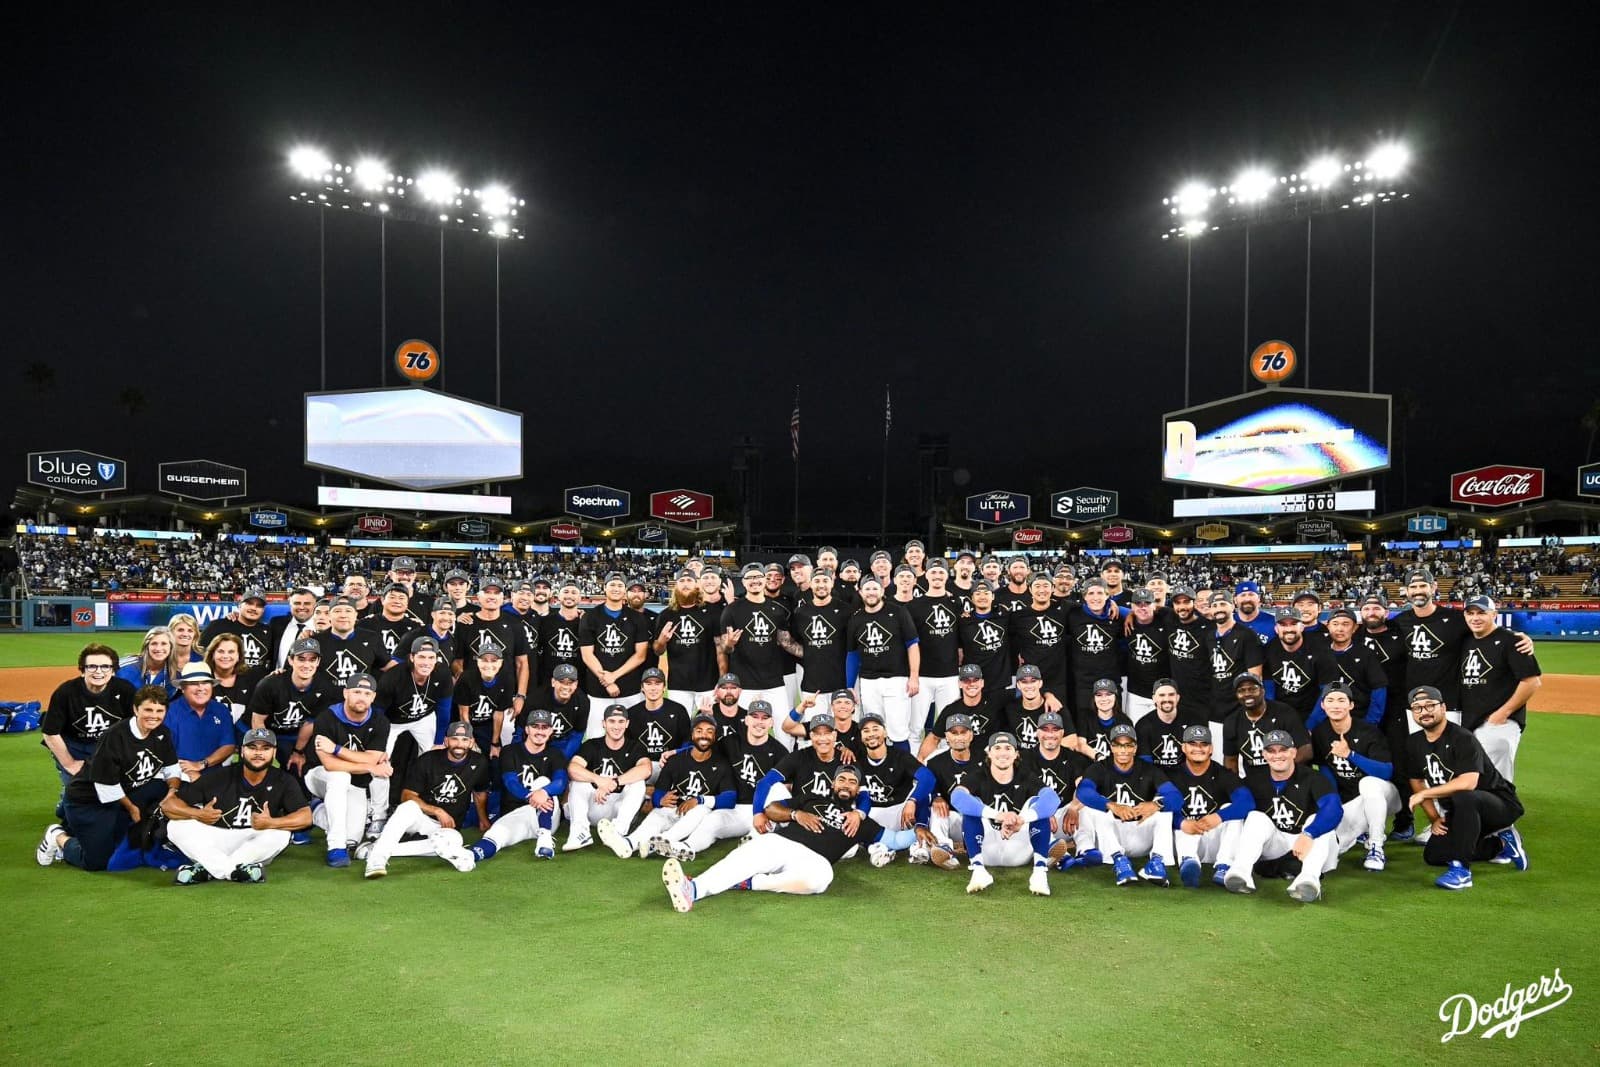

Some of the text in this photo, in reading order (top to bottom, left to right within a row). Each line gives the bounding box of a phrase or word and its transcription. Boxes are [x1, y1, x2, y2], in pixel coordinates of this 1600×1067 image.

[404, 351, 432, 372] 76
[1260, 350, 1288, 372] 76
[38, 456, 92, 476] blue
[46, 475, 98, 486] california
[166, 474, 240, 486] GUGGENHEIM
[1459, 473, 1534, 498] Coca-Cola
[572, 496, 620, 508] Spectrum
[980, 500, 1016, 510] ULTRA
[1076, 495, 1111, 506] Security
[1076, 504, 1106, 514] Benefit
[1308, 500, 1315, 510] 0
[1318, 499, 1324, 510] 0
[1327, 498, 1334, 510] 0
[364, 518, 386, 528] JINRO
[1412, 518, 1442, 530] TEL
[1014, 532, 1040, 541] Churu
[76, 611, 92, 622] 76
[680, 616, 695, 637] LA
[752, 612, 768, 636] LA
[812, 616, 826, 638] LA
[932, 605, 950, 628] LA
[1037, 616, 1057, 638] LA
[606, 624, 620, 646] LA
[866, 623, 883, 646] LA
[978, 622, 999, 644] LA
[1086, 624, 1103, 646] LA
[1411, 625, 1432, 651] LA
[1135, 634, 1152, 656] LA
[1213, 648, 1226, 672] LA
[1464, 650, 1481, 676] LA
[1282, 661, 1301, 686] LA
[283, 702, 303, 724] LA
[410, 694, 428, 715] LA
[475, 695, 492, 717] LA
[85, 707, 110, 732] LA
[1021, 718, 1037, 742] LA
[647, 723, 663, 746] LA
[1248, 731, 1264, 757] LA
[1162, 735, 1178, 758] LA
[136, 749, 154, 780] LA
[741, 754, 757, 782] LA
[1425, 754, 1446, 784] LA
[440, 775, 458, 797] LA
[686, 772, 702, 796] LA
[811, 772, 830, 797] LA
[865, 775, 884, 798] LA
[1116, 784, 1135, 807] LA
[1188, 787, 1207, 815] LA
[825, 804, 844, 822] LA
[1272, 798, 1294, 826] LA
